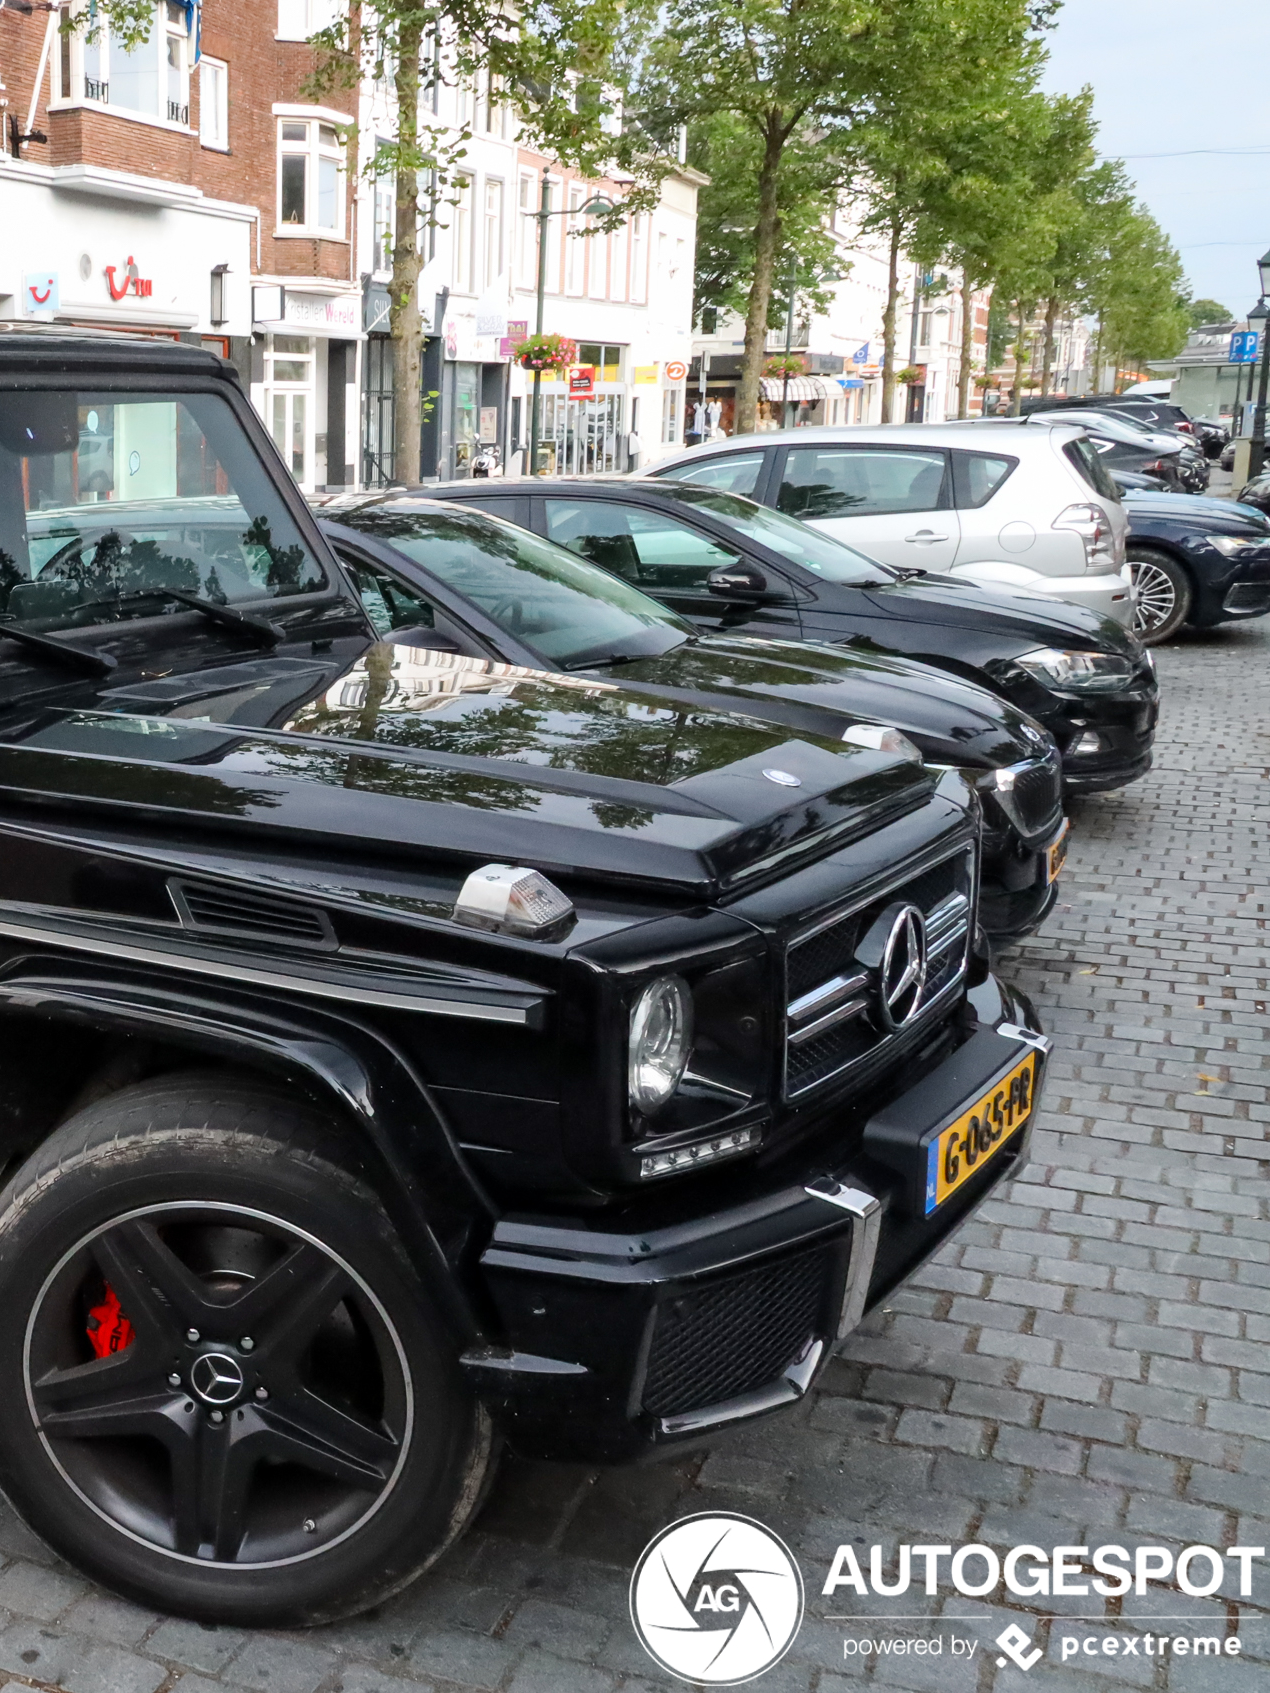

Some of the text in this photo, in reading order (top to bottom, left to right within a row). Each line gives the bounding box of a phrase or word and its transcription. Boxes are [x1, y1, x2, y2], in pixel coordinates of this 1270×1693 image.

[134, 277, 153, 296] TUI
[1233, 335, 1256, 351] P P
[945, 1067, 1030, 1184] G-065-PR
[925, 1184, 936, 1198] NL
